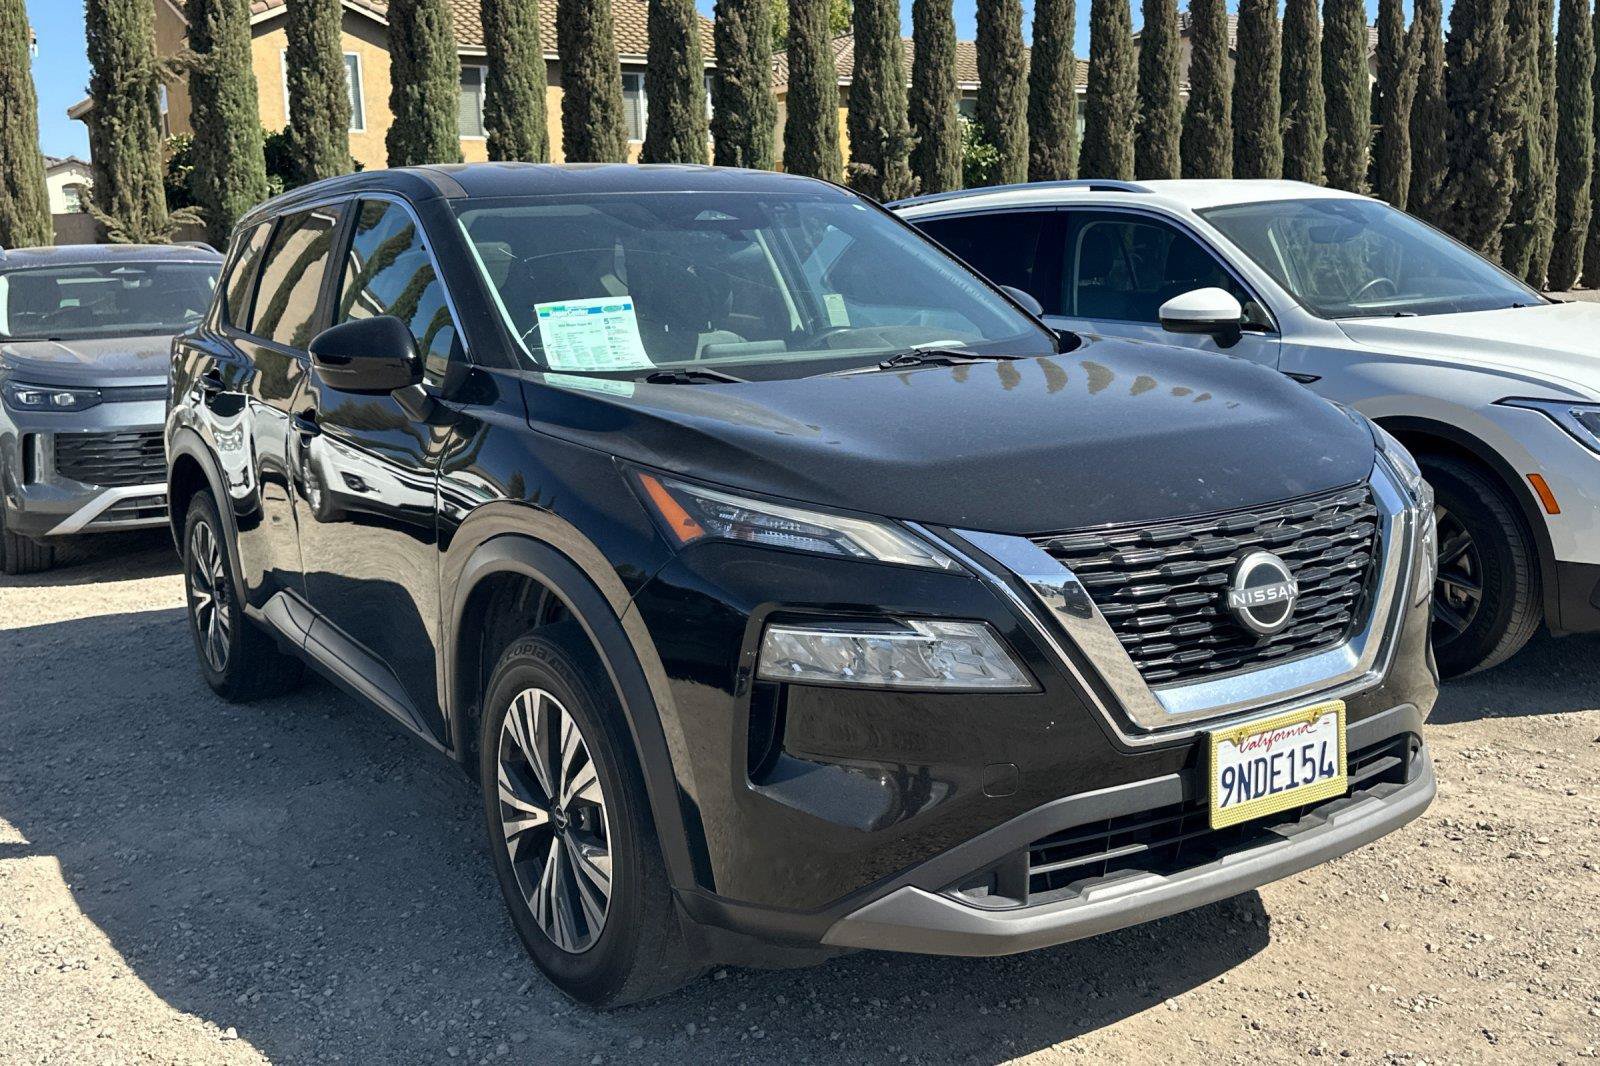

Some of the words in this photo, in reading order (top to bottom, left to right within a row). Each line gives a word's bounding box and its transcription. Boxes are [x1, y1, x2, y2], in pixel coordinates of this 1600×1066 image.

[1232, 583, 1298, 605] NISSAN
[1239, 724, 1317, 753] California
[1221, 741, 1335, 808] 9NDE154
